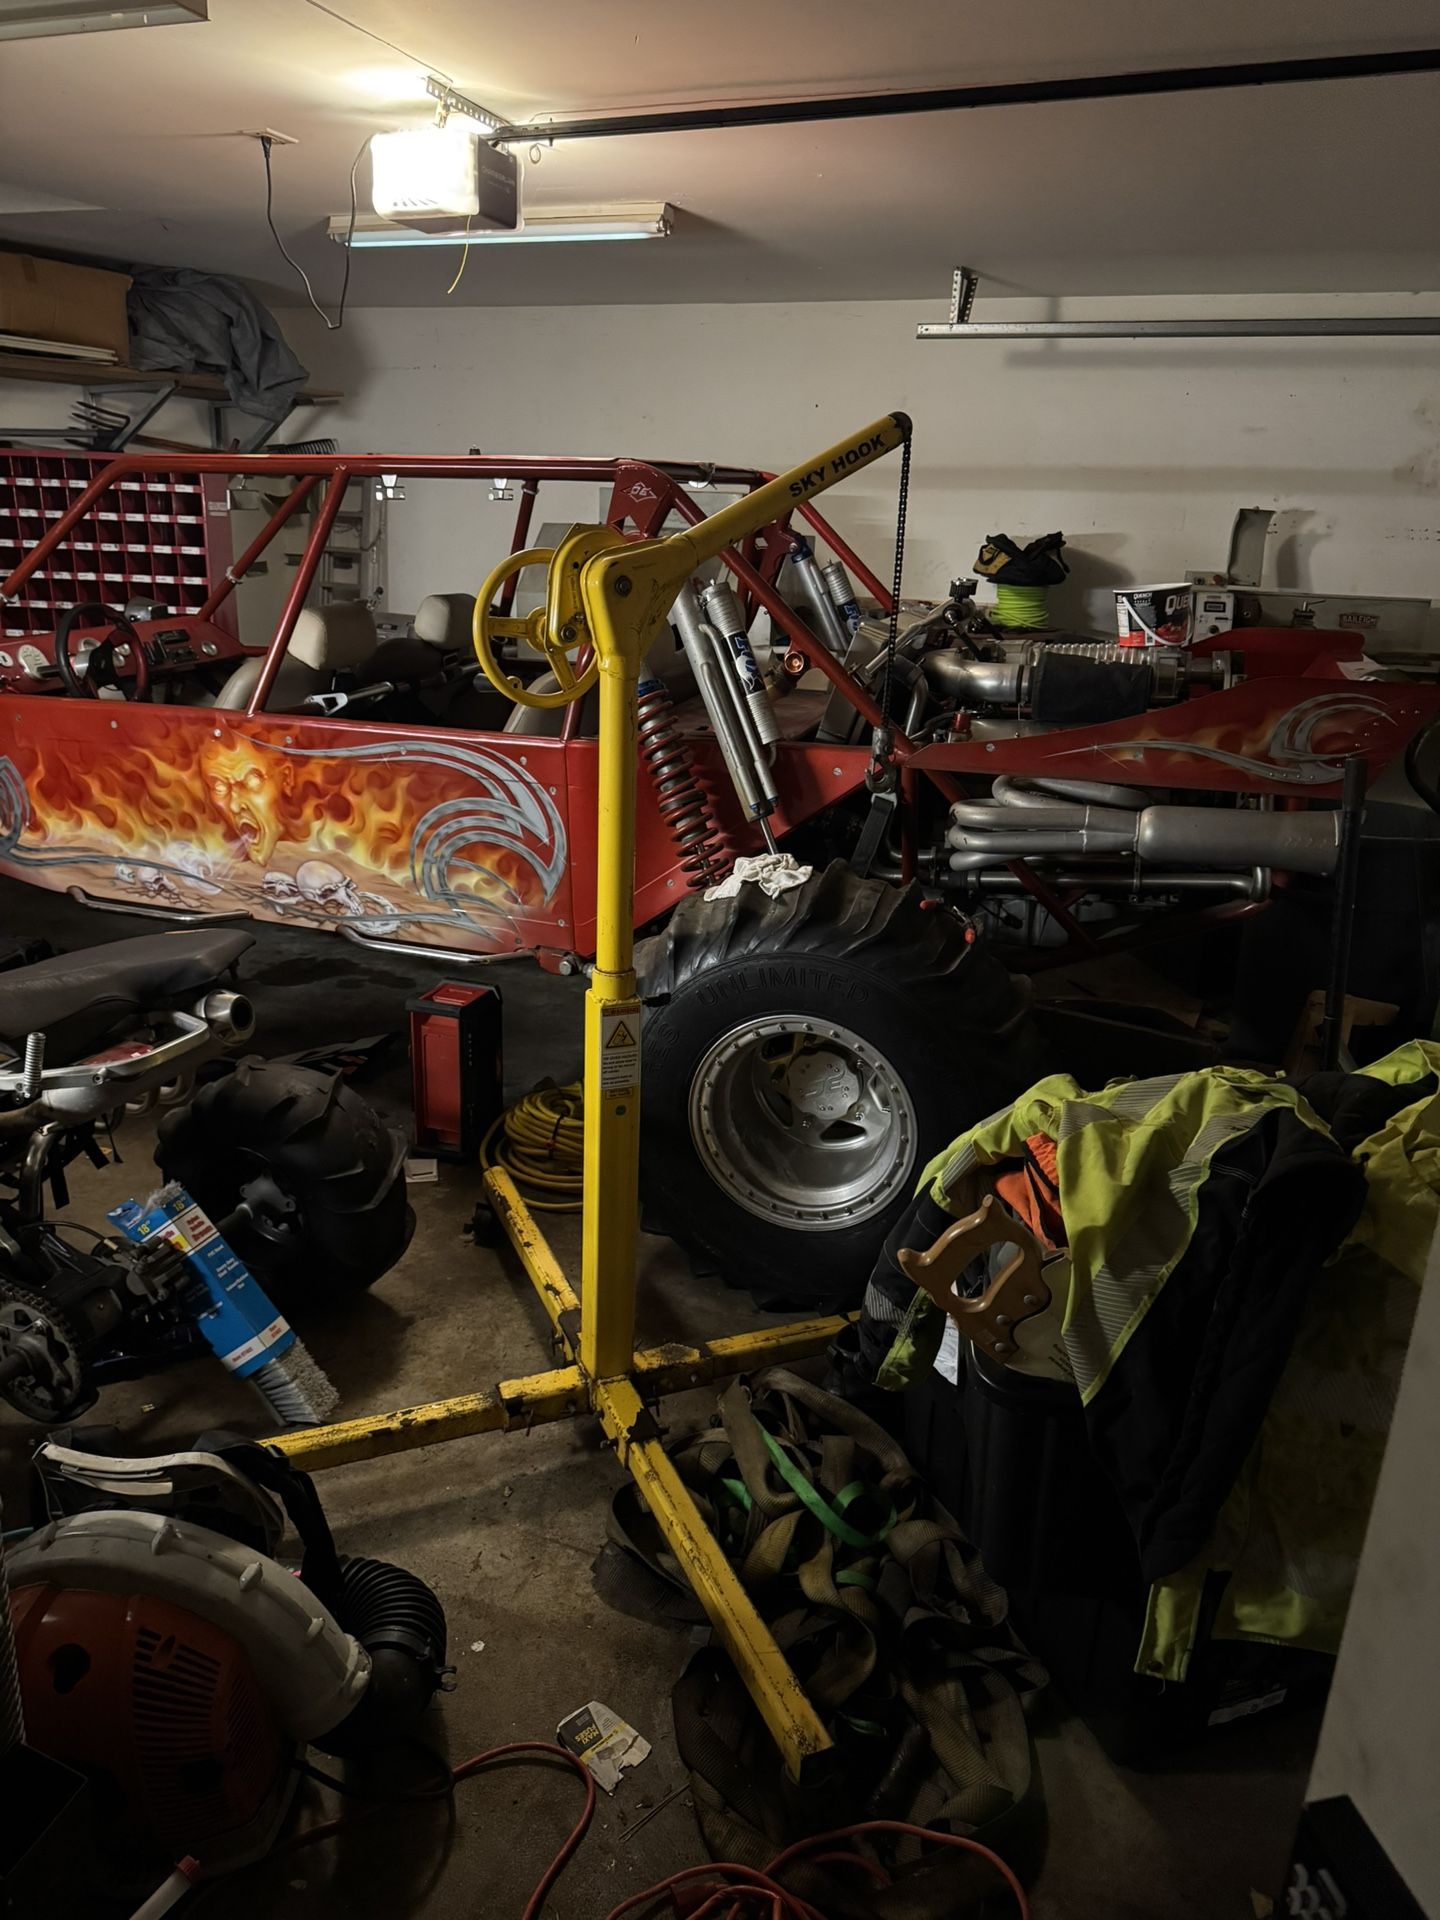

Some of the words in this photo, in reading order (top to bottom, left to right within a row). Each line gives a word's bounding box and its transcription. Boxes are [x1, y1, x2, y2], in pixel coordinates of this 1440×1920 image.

[788, 467, 827, 499] SKY
[832, 433, 886, 474] HOOK
[696, 965, 870, 1008] UNLIMITED
